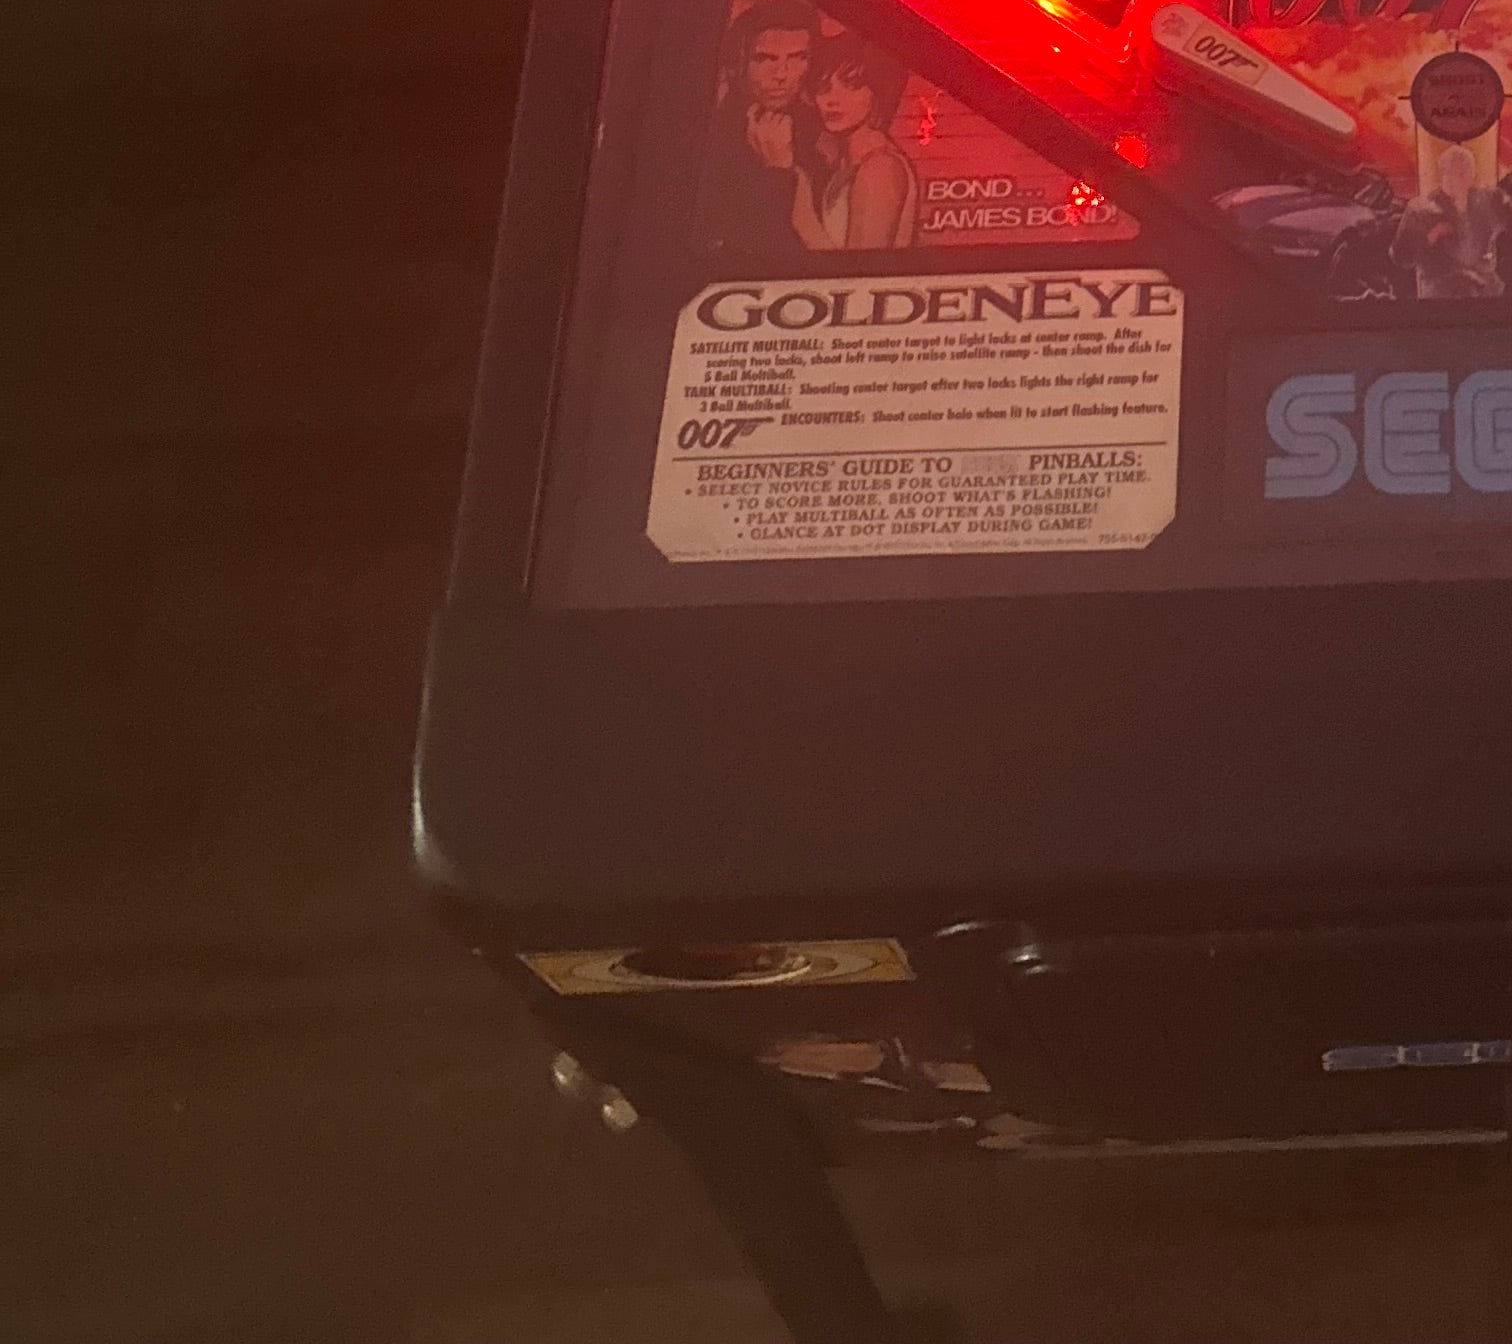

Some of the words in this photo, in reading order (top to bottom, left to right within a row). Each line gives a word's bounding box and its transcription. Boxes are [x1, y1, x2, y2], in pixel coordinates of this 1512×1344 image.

[1193, 34, 1250, 69] 007
[924, 205, 1021, 230] JAMES
[697, 277, 1177, 332] GOLDENEYE
[690, 340, 749, 355] SATELLITE
[753, 338, 824, 353] MULTIBALL:
[831, 337, 863, 350] Shoot
[866, 337, 901, 350] center
[904, 334, 941, 349] target
[944, 334, 956, 345] to
[959, 332, 985, 346] light
[989, 332, 1016, 345] locks
[1020, 332, 1032, 344] at
[1035, 331, 1070, 343] center
[1074, 331, 1107, 344] ramp.
[1114, 327, 1142, 339] After
[706, 355, 747, 369] scoring
[750, 355, 771, 367] two
[774, 352, 806, 367] locks,
[810, 352, 841, 364] shoot
[844, 351, 865, 363] left
[868, 351, 898, 364] ramp
[902, 350, 914, 362] to
[917, 348, 946, 361] raise
[951, 347, 996, 360] satellite
[1000, 347, 1030, 360] ramp
[1042, 344, 1068, 357] then
[1071, 343, 1103, 356] shoot
[1106, 342, 1125, 354] the
[1128, 341, 1152, 353] dish
[1155, 340, 1172, 352] for
[684, 385, 715, 398] TANK
[720, 384, 793, 397] MULTIBALL:
[800, 382, 849, 396] Shooting
[853, 382, 888, 394] center
[891, 381, 928, 394] target
[930, 378, 960, 391] after
[963, 378, 984, 390] two
[987, 377, 1017, 389] locks
[1019, 375, 1051, 390] lights
[1054, 374, 1074, 386] the
[1076, 372, 1105, 387] right
[1107, 373, 1139, 386] ramp
[1141, 371, 1159, 383] for
[714, 370, 737, 382] Ball
[710, 400, 733, 412] Ball
[677, 416, 762, 449] 007
[781, 412, 866, 426] ENCOUNTERS:
[872, 411, 905, 423] Shoot
[908, 409, 943, 422] center
[976, 407, 1007, 419] when
[1010, 405, 1022, 418] lit
[1025, 406, 1038, 418] to
[1041, 405, 1069, 417] start
[1072, 402, 1119, 418] flashing
[1122, 401, 1168, 415] feature.
[698, 460, 836, 482] BEGINNERS'
[843, 458, 914, 476] GUIDE
[921, 457, 952, 474] TO
[1028, 451, 1143, 471] PINBALLS:
[697, 482, 763, 497] SELECT
[768, 481, 832, 495] NOVICE
[838, 478, 892, 492] RULES
[897, 477, 932, 490] FOR
[938, 475, 1052, 489] GUARANTEED
[1058, 471, 1099, 486] PLAY
[736, 497, 759, 510] TO
[764, 496, 823, 509] SCORE
[889, 491, 947, 505] SHOOT
[953, 489, 1016, 503] WHAT'S
[1021, 486, 1112, 501] FLASHING!
[746, 512, 788, 526] PLAY
[793, 510, 890, 524] MULTIBALL
[894, 508, 917, 520] AS
[921, 506, 979, 520] OFTEN
[983, 505, 1006, 518] AS
[1011, 502, 1098, 517] POSSIBLE!
[822, 525, 846, 538] AT
[851, 524, 885, 537] DOT
[890, 521, 961, 535] DISPLAY
[967, 519, 1033, 533] DURING
[1038, 517, 1093, 531] GAME!
